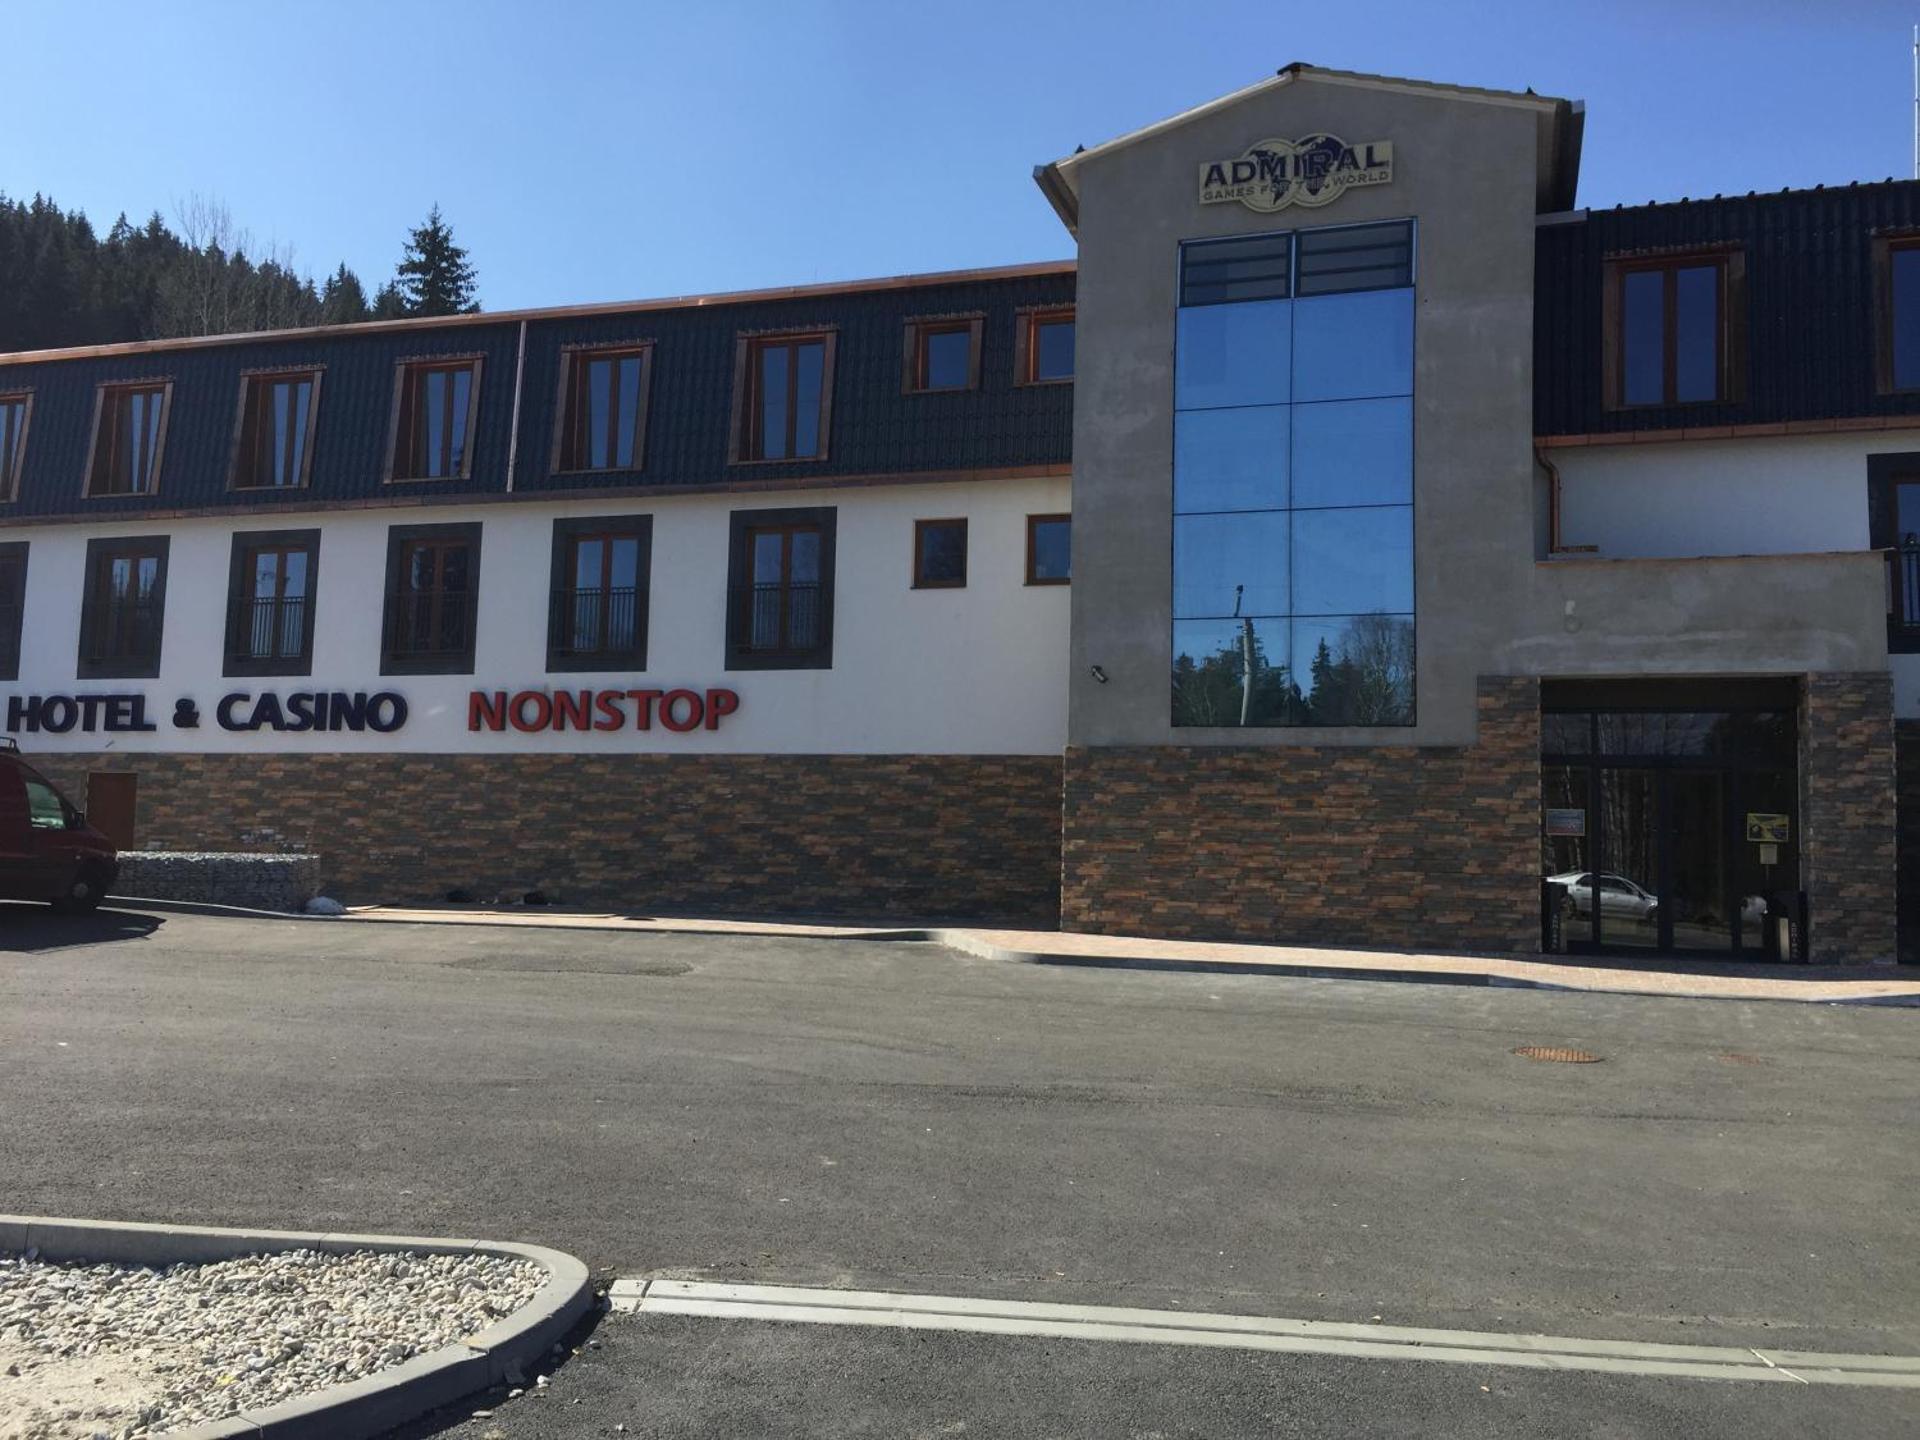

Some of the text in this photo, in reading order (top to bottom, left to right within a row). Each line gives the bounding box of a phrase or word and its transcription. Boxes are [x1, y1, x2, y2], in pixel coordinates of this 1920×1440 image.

[1203, 185, 1255, 200] GAMES
[1333, 171, 1389, 186] WORLD
[1204, 145, 1388, 188] ADMIRAL
[6, 692, 408, 733] HOTEL & CASINO
[468, 689, 740, 732] NONSTOP
